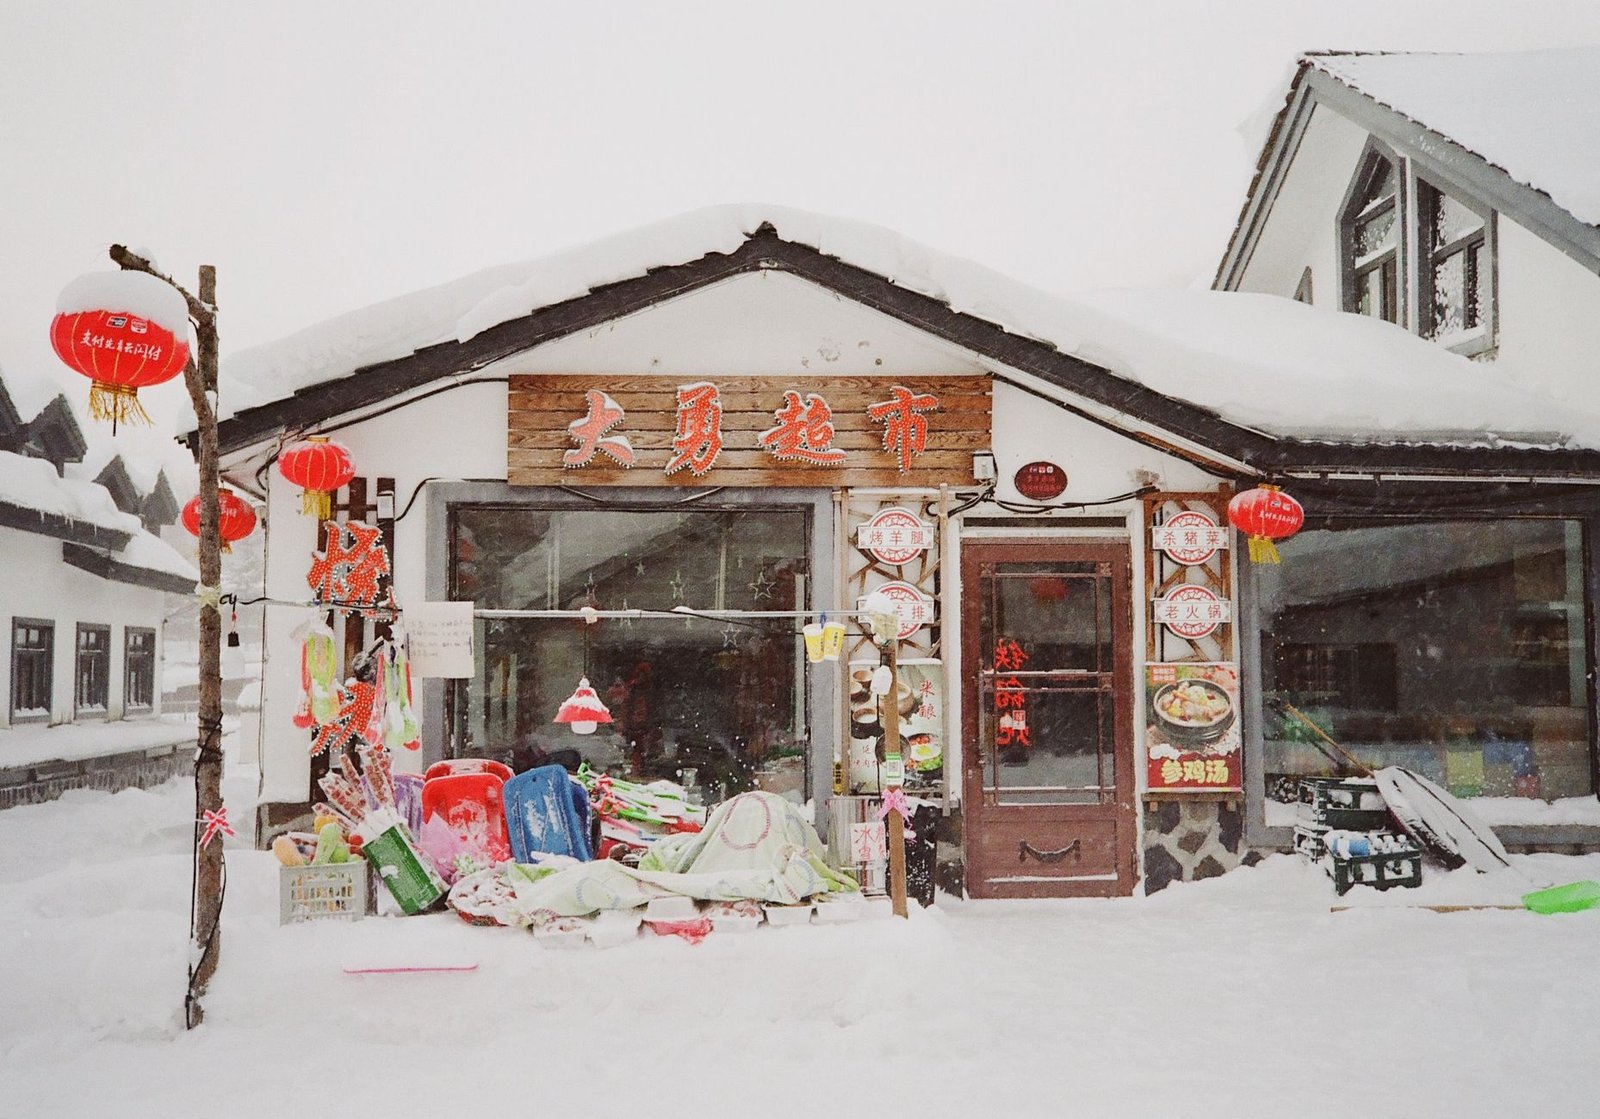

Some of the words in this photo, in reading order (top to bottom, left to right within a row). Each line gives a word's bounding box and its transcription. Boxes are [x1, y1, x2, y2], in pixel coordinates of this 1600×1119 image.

[562, 381, 939, 477] 大勇超市
[869, 530, 925, 546] 烤羊腿
[1163, 530, 1220, 546] 杀猪菜
[1165, 604, 1222, 619] 老火锅
[918, 679, 936, 720] 米酿
[1161, 759, 1229, 785] 参鸡汤
